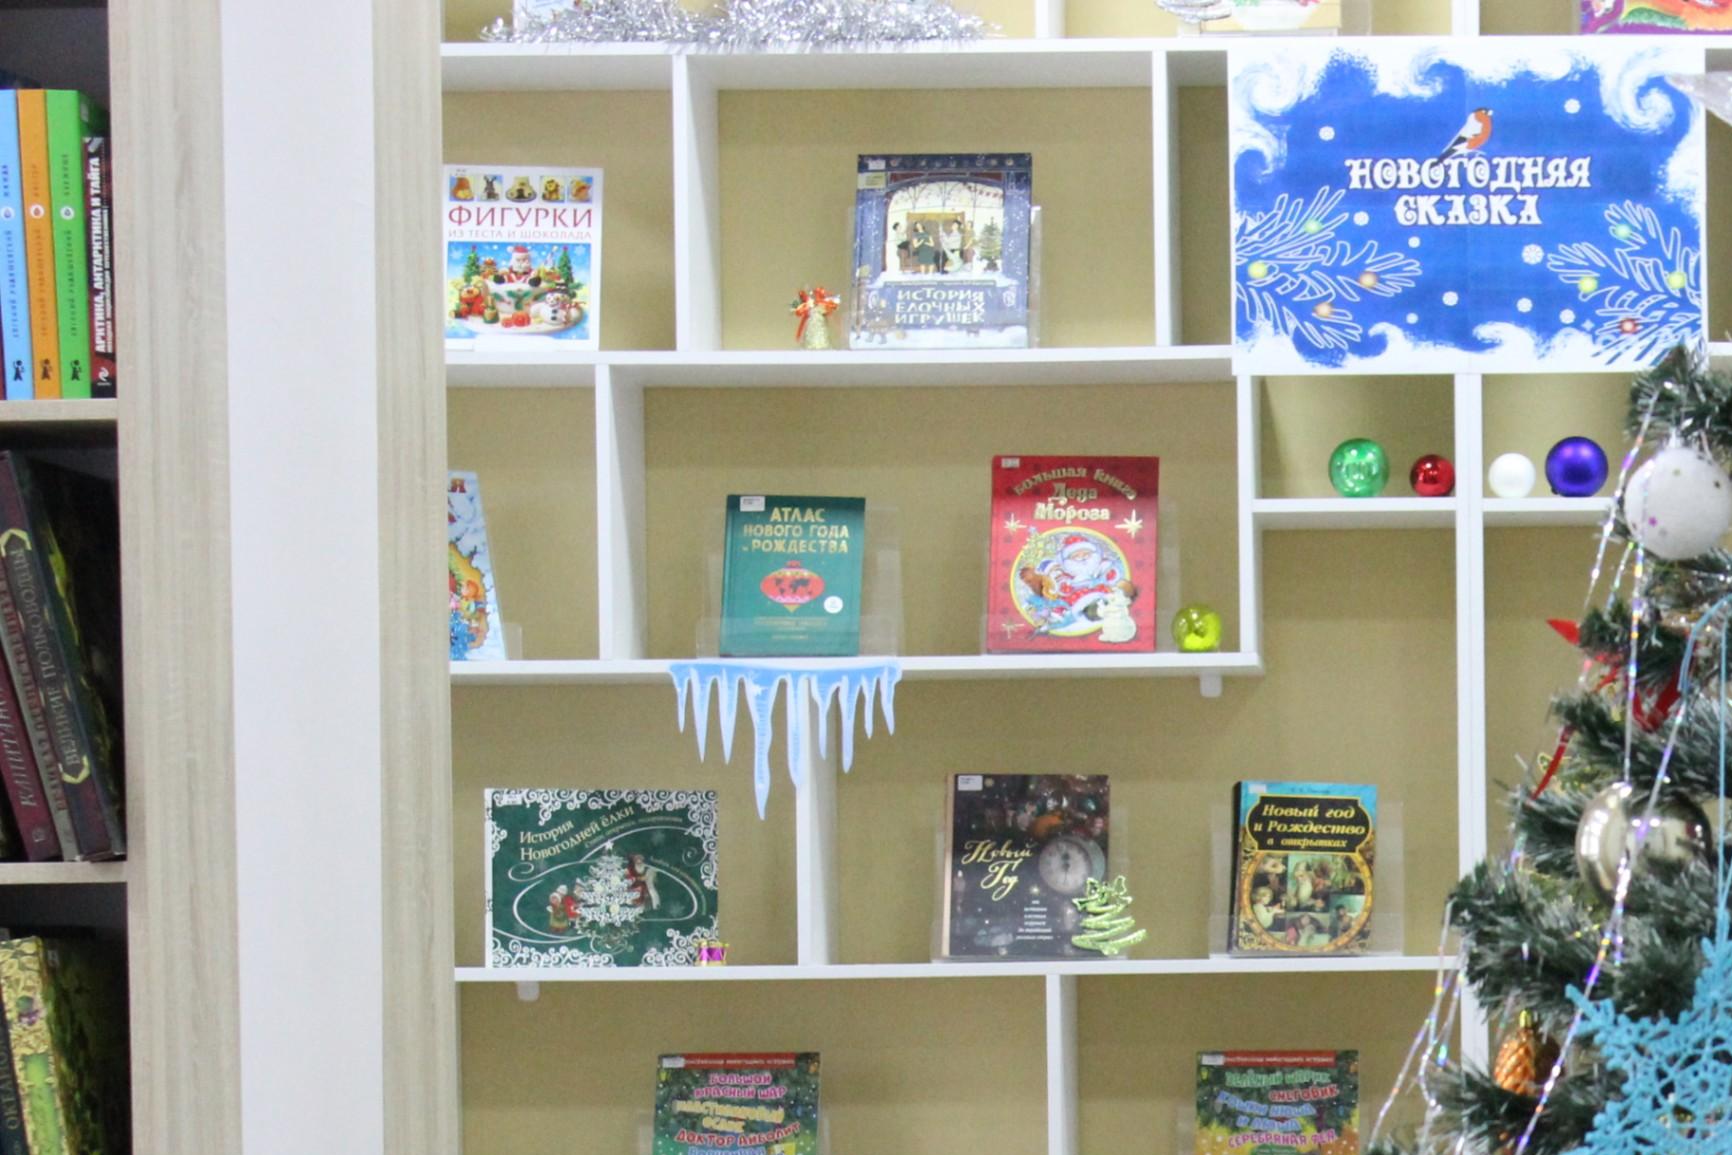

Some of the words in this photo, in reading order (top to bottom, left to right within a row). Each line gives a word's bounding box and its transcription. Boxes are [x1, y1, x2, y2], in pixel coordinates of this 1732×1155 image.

[87, 157, 100, 196] ТАЙГА
[1344, 156, 1592, 191] НОВОГОДНЯЯ
[448, 205, 592, 228] ФИГУРКИ
[1394, 193, 1544, 227] СКАЗКА
[468, 229, 503, 239] ТЕСТА
[507, 229, 516, 239] И
[520, 230, 592, 240] ШОКОЛАДА
[90, 209, 103, 289] АНТАРКТИКА
[896, 287, 985, 302] ИСТОРИЯ
[92, 293, 106, 353] АРКТИКА,
[895, 312, 985, 325] ИГРУШЕК
[1048, 482, 1098, 505] Деда
[770, 507, 825, 522] АТЛАС
[1033, 502, 1111, 524] Мороза
[743, 524, 803, 538] НОВОГО
[809, 525, 849, 538] ГОДА
[752, 539, 849, 553] РОЖДЕСТВА
[9, 547, 57, 679] ПОЛКОВОДЦЫ
[45, 685, 80, 765] ВЕЛИКИЕ
[1262, 804, 1319, 818] Новый
[1325, 806, 1356, 819] год
[519, 820, 574, 844] История
[1254, 823, 1262, 832] и
[1267, 820, 1365, 835] Рождество
[961, 839, 1038, 865] Новый
[1281, 837, 1348, 849] открытках
[980, 858, 1023, 901] Год
[708, 1073, 773, 1086] БОЛЬШОЙ
[694, 1086, 755, 1099] КРАСНЫЙ
[757, 1086, 787, 1099] ШАР
[675, 1128, 735, 1146] ДОКТОР
[1228, 1131, 1308, 1149] СЕРЕБРЯНАЯ
